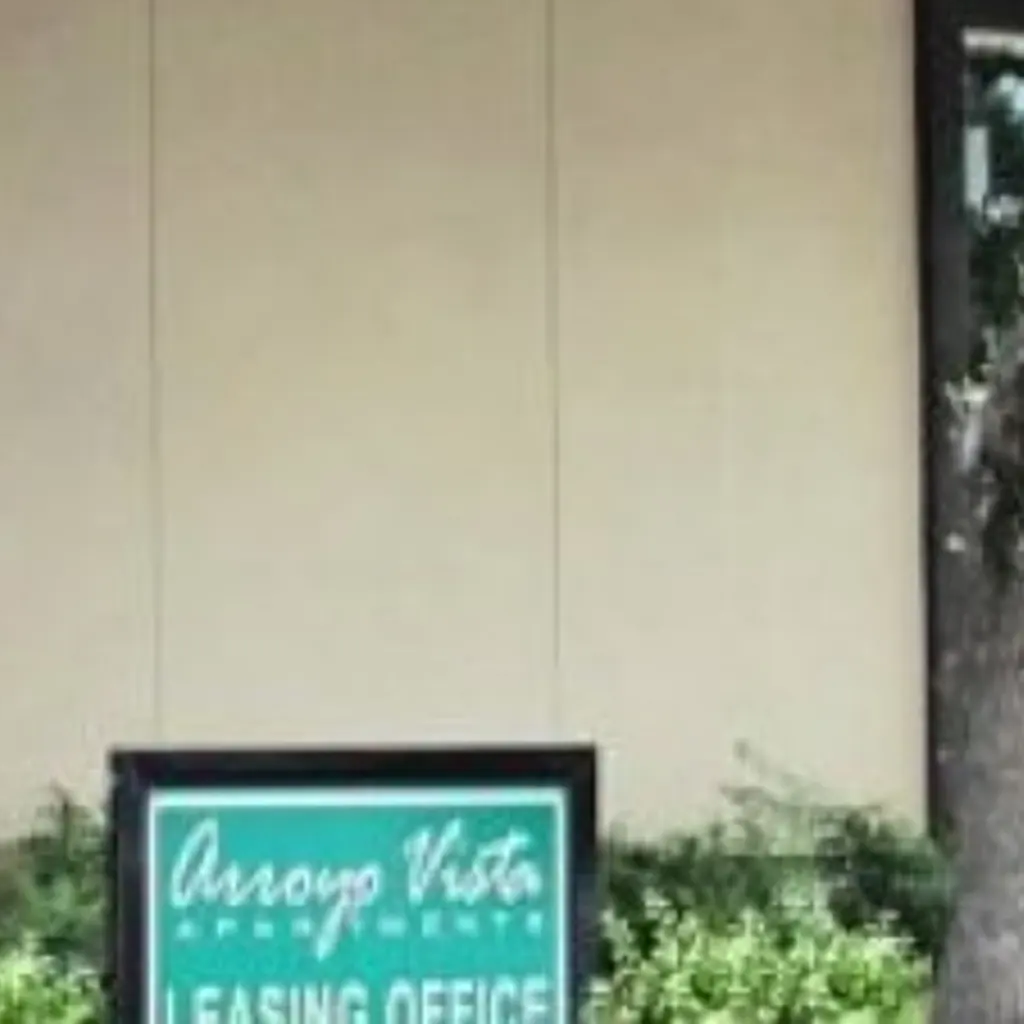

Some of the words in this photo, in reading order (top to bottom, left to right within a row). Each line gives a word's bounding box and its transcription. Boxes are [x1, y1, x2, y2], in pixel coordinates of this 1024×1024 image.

[171, 817, 380, 962] Arroyo
[403, 817, 543, 906] Vista
[385, 975, 547, 1024] OFFICE
